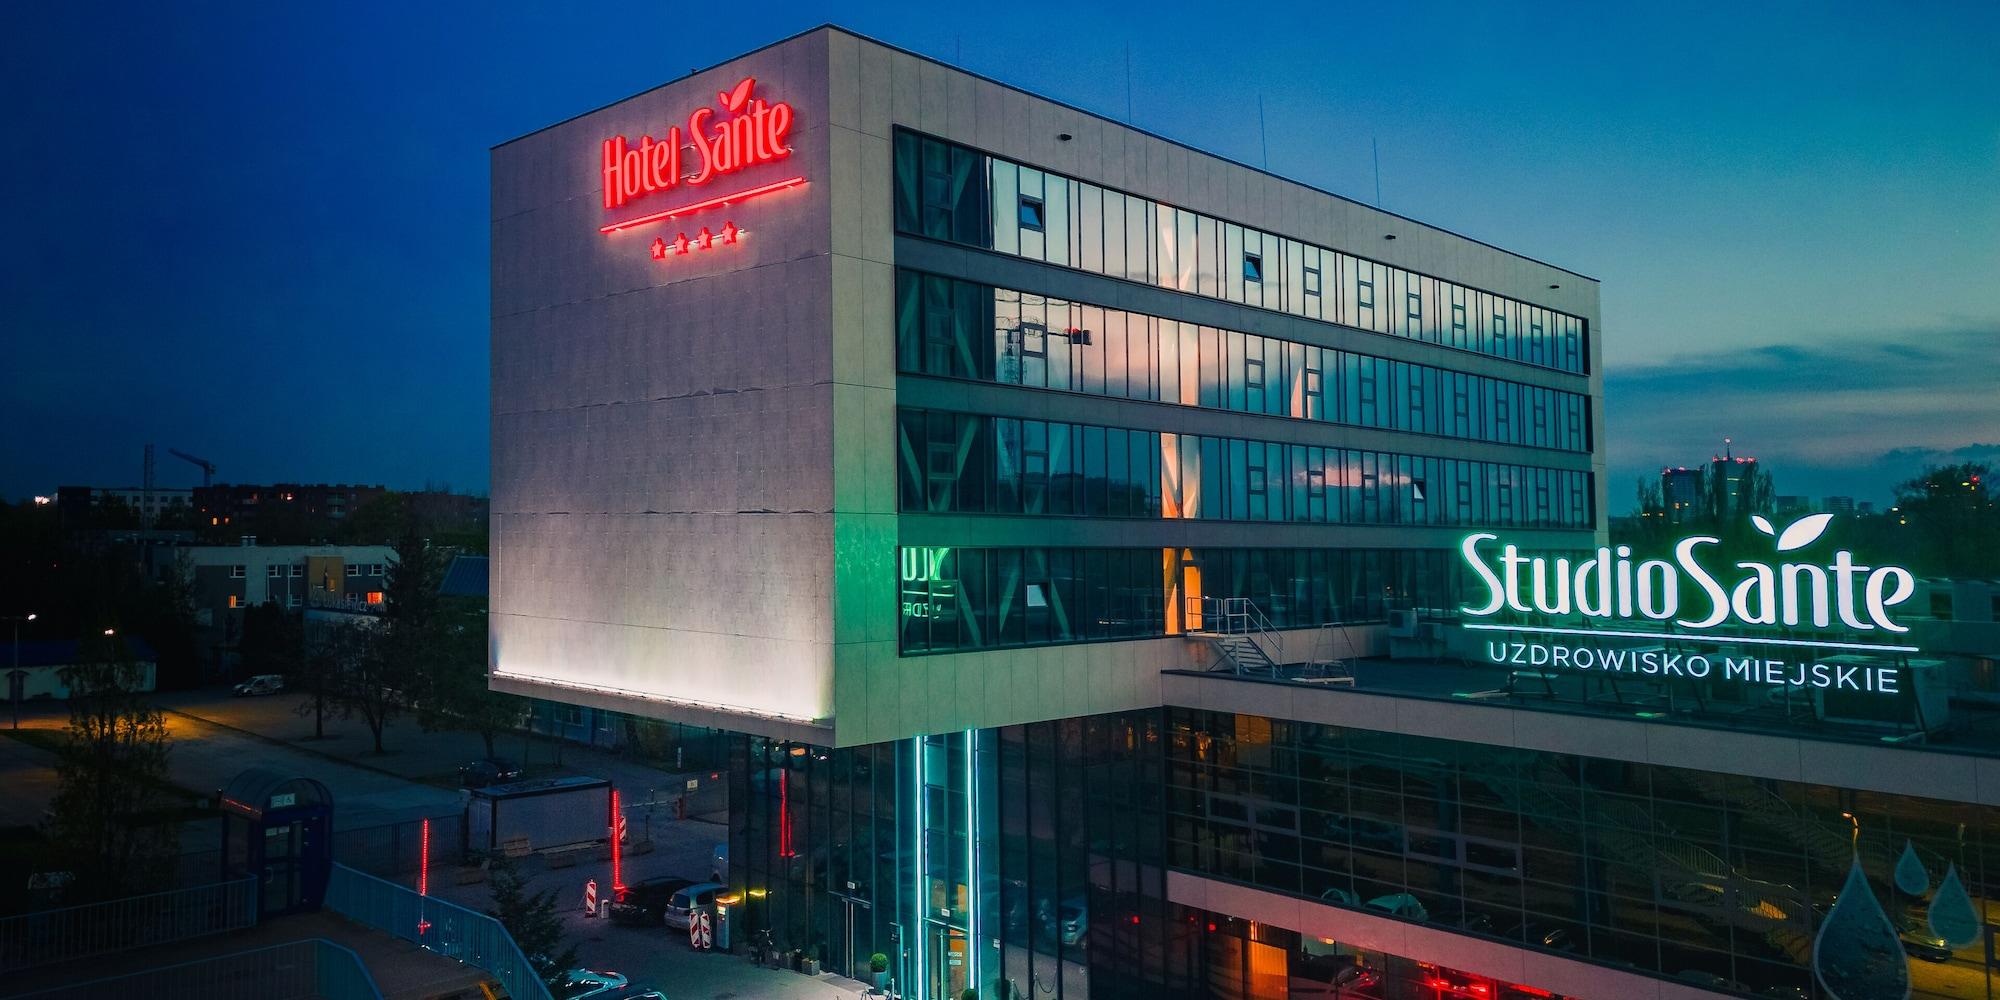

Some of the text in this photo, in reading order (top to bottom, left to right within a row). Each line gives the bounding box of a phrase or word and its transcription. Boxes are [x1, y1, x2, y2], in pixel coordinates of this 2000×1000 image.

[602, 98, 793, 208] Hotel Sante
[1489, 641, 1899, 694] UZDROWISKO MIEJSKIE
